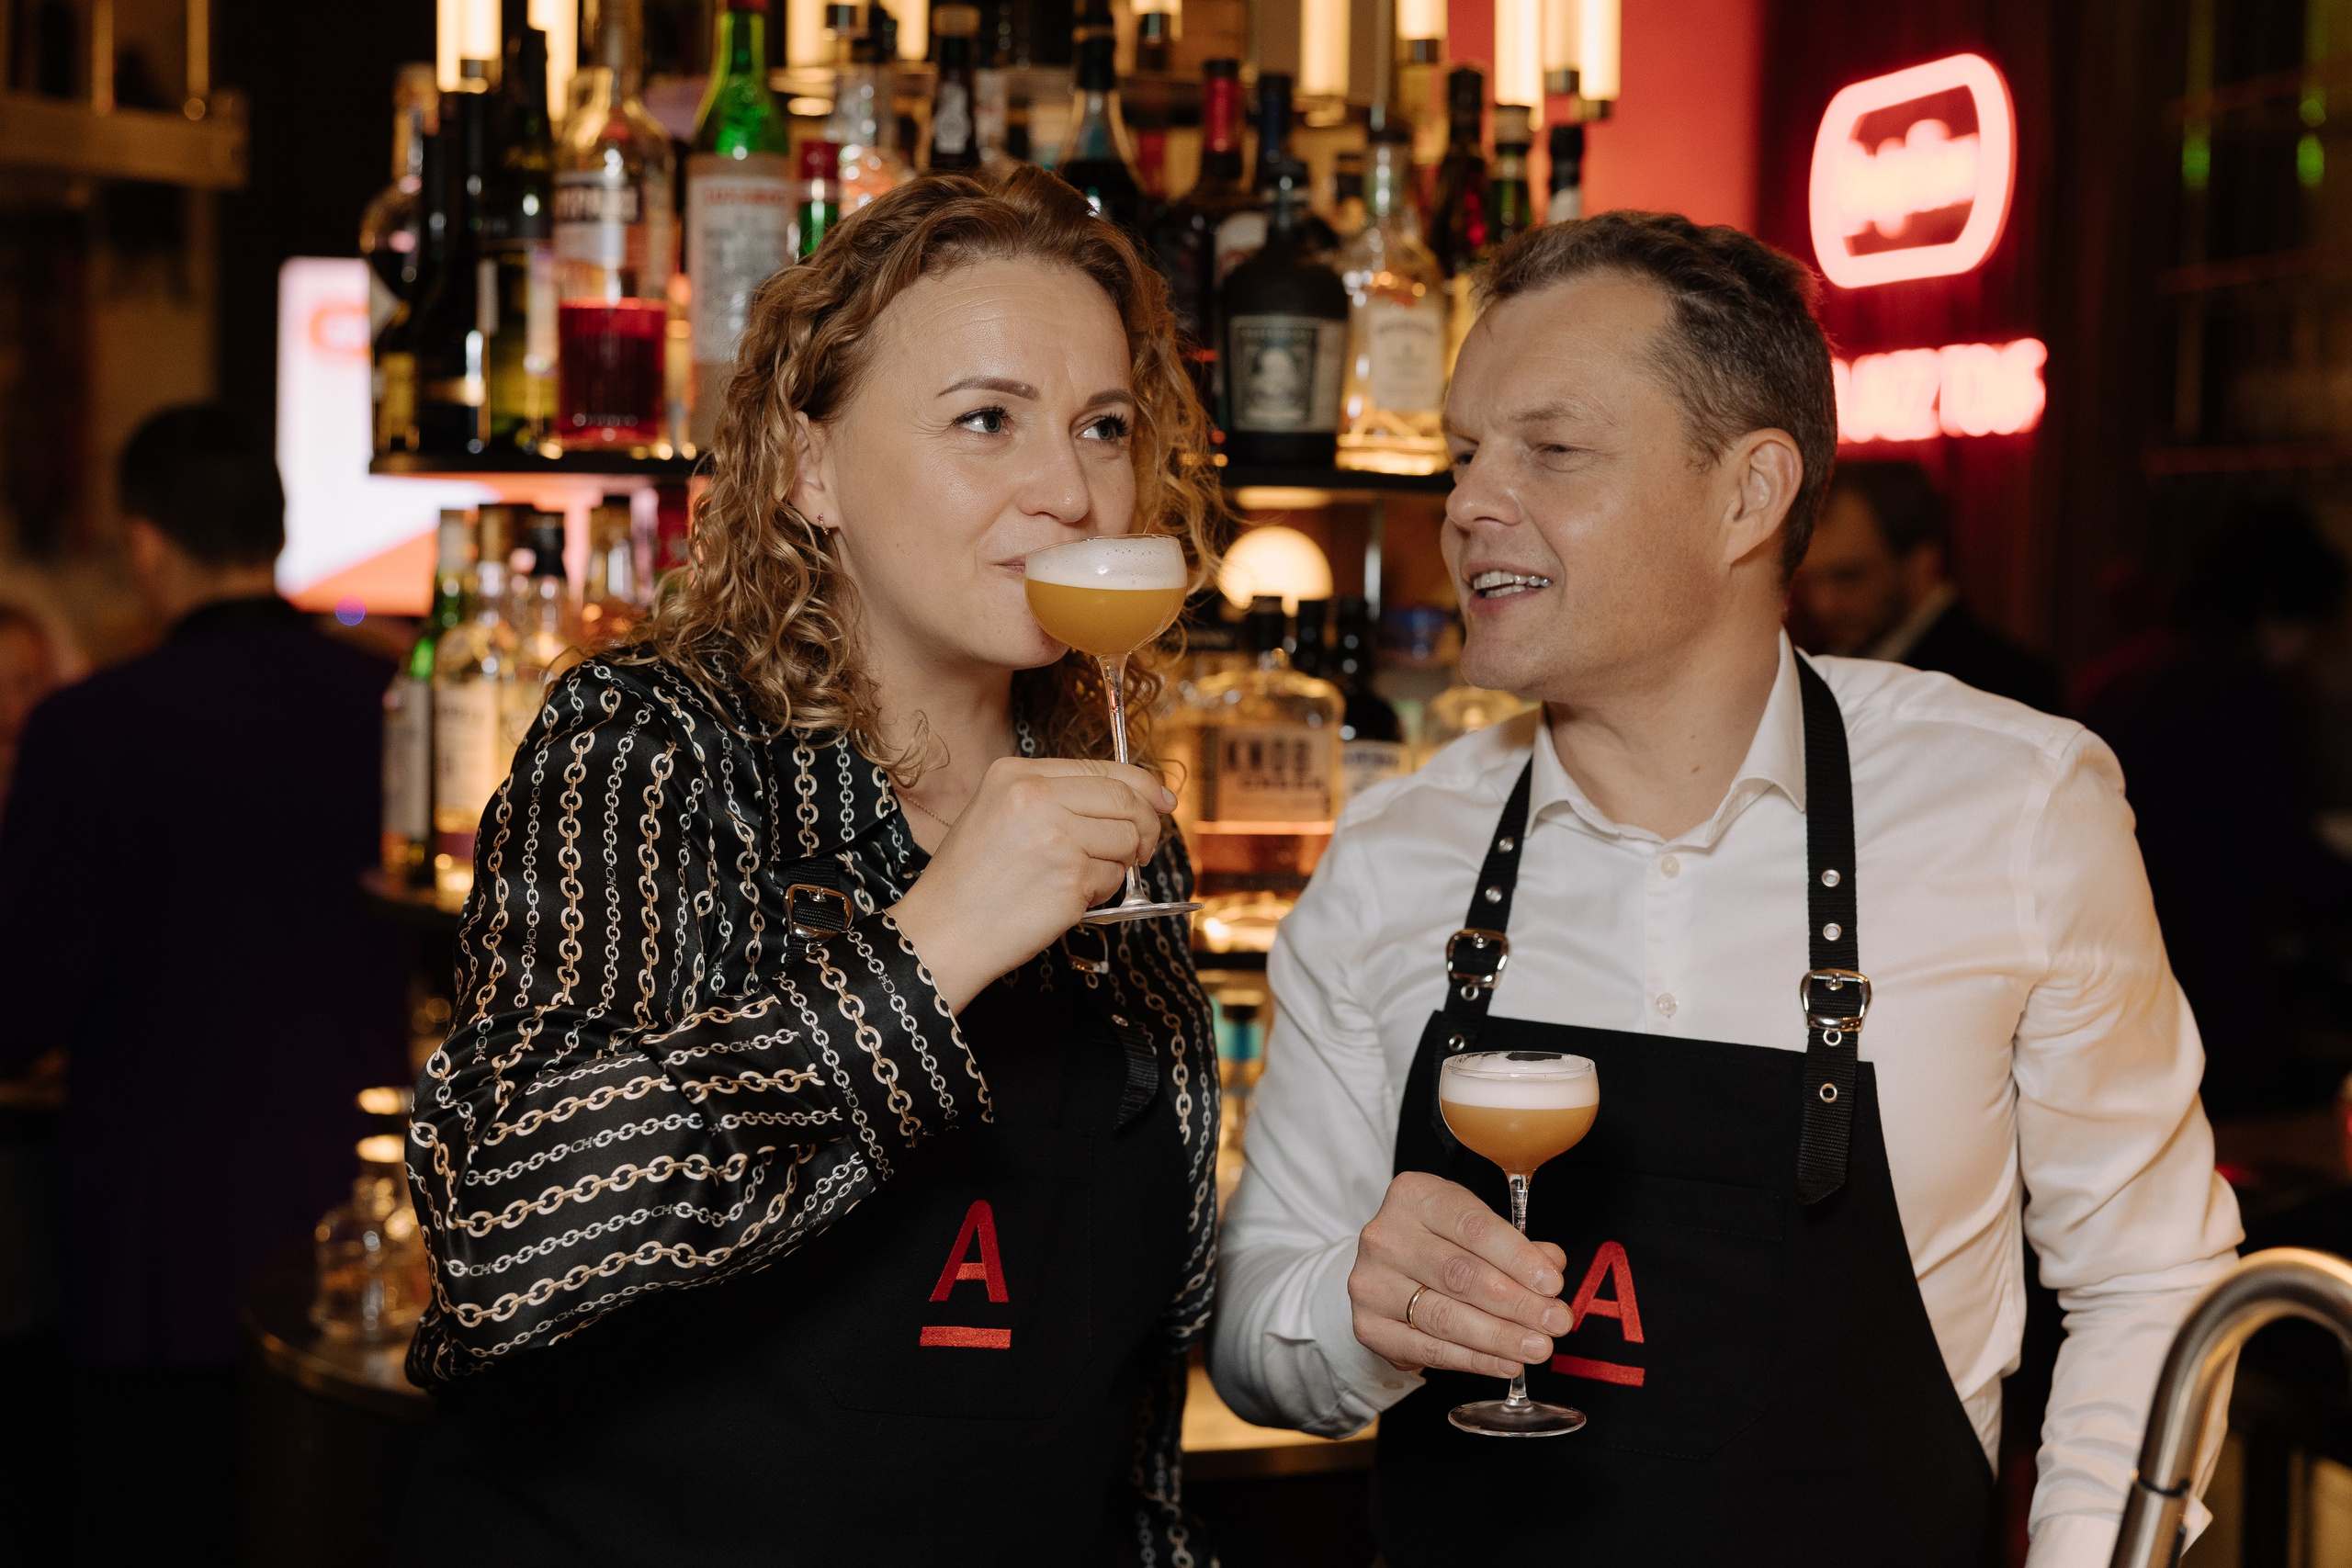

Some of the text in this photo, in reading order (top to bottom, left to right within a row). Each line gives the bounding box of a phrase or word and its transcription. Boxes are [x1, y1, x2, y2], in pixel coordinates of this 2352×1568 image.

[605, 867, 616, 886] CH
[729, 1041, 752, 1053] CH
[571, 1136, 594, 1153] CH
[651, 1204, 673, 1218] CH
[929, 1200, 1009, 1303] A
[469, 1263, 492, 1276] CH
[1570, 1241, 1645, 1343] A
